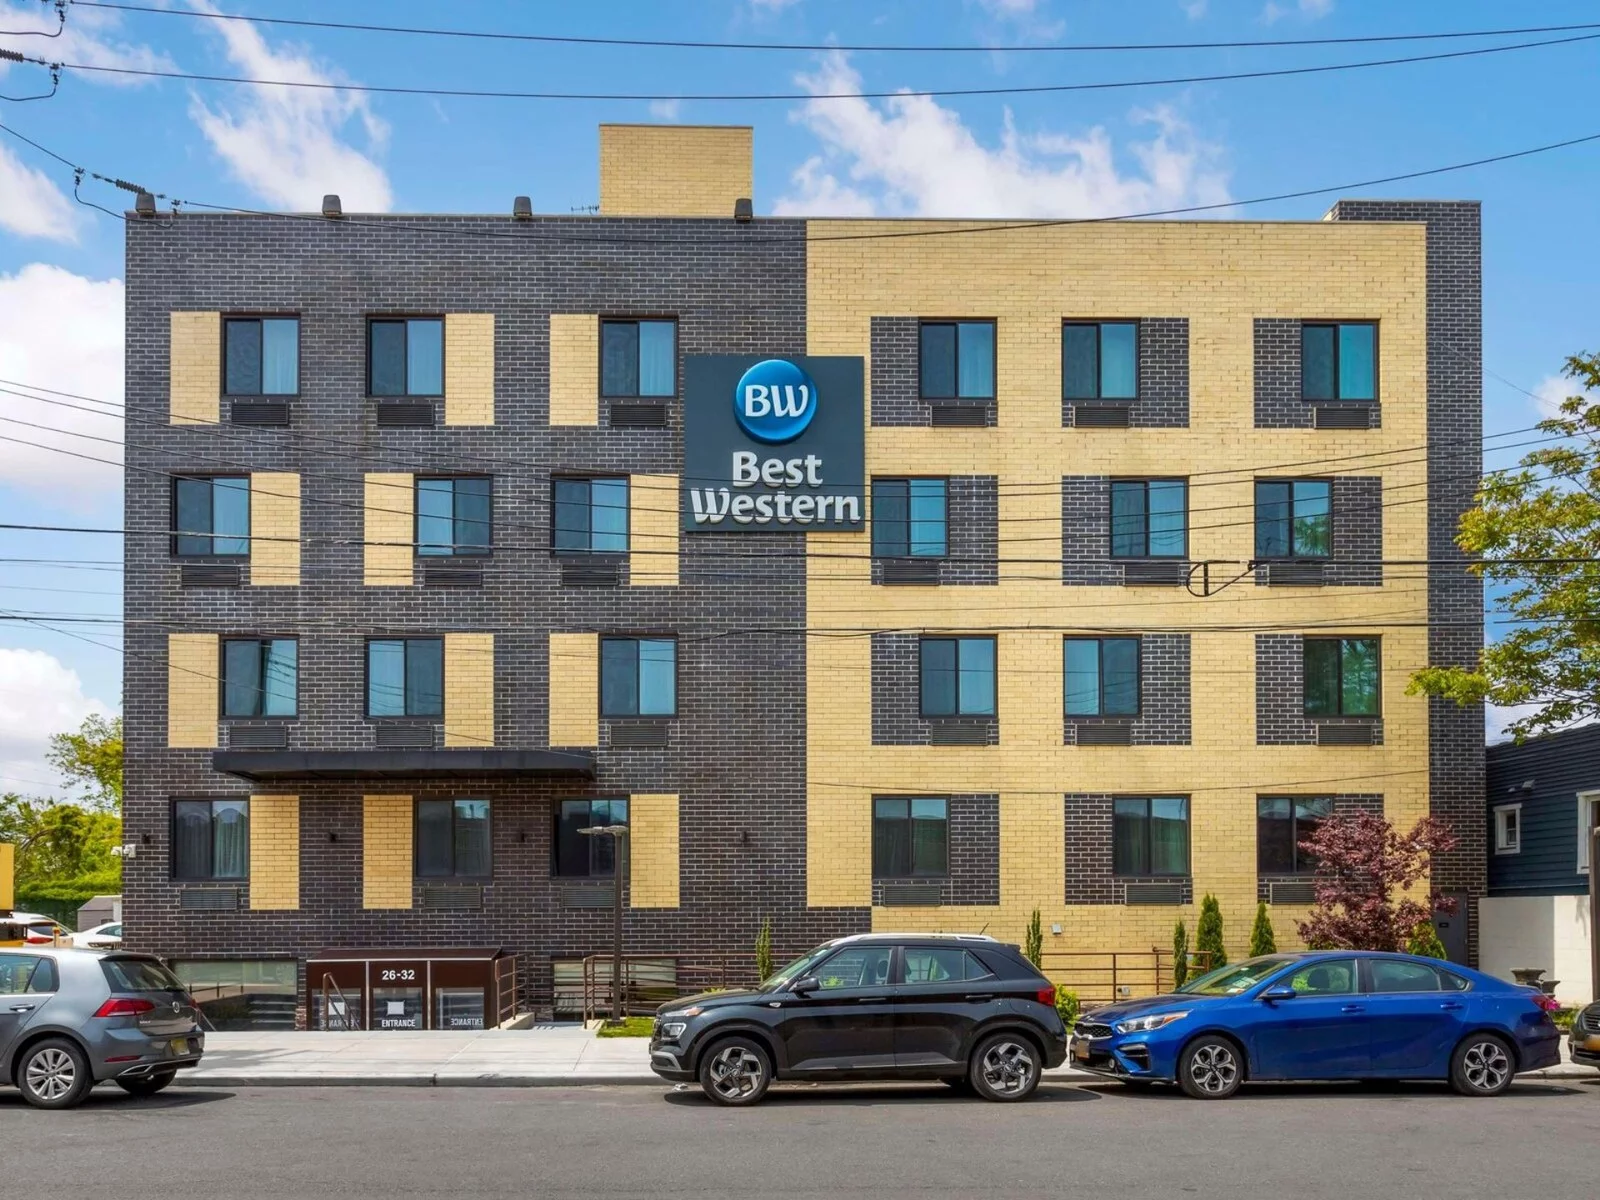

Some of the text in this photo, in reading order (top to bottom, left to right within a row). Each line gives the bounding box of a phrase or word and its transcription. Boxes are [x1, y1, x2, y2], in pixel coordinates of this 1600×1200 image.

[744, 384, 809, 418] BW
[732, 451, 824, 488] Best
[690, 487, 861, 525] Western
[382, 969, 415, 980] 26-32
[381, 1019, 416, 1028] ENTRANCE
